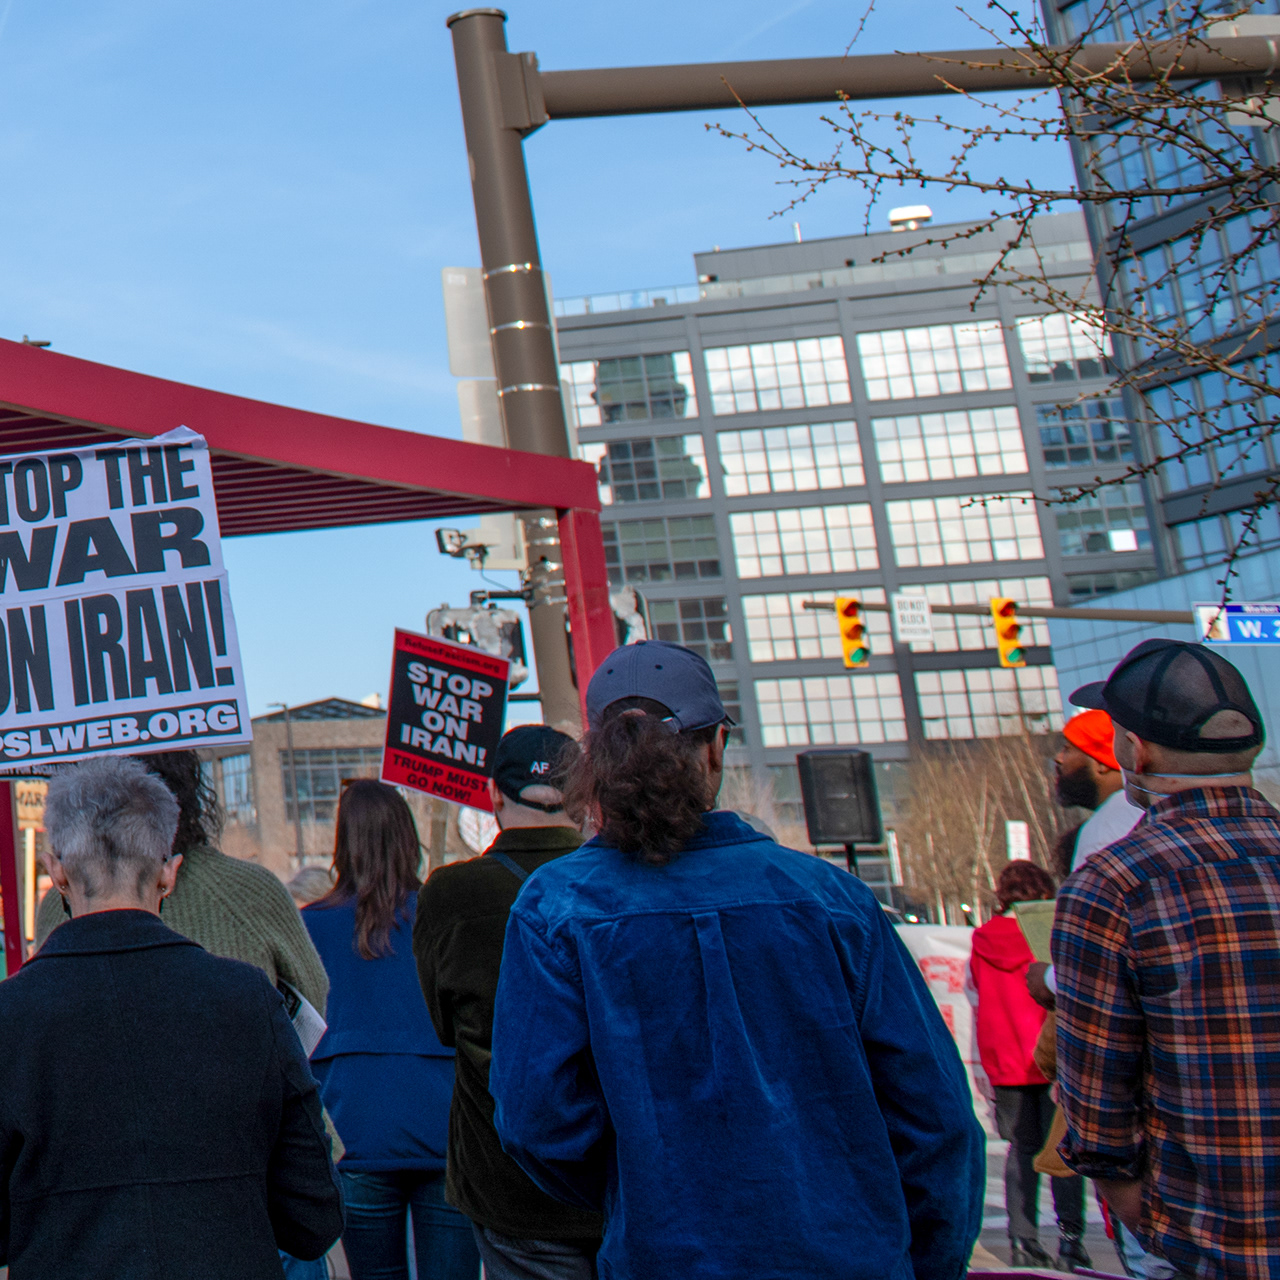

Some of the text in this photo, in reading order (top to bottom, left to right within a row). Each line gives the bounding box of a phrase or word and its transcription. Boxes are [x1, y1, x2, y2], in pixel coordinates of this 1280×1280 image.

[95, 443, 201, 510] THE
[899, 613, 927, 625] BLOCK
[909, 600, 925, 611] NOT
[64, 579, 235, 707] IRAN!
[1235, 619, 1269, 639] W.
[407, 661, 494, 701] STOP
[411, 683, 483, 723] WAR
[421, 709, 469, 741] ON
[400, 723, 487, 768] IRAN!
[392, 754, 488, 793] TRUMP MUST
[530, 761, 550, 775] AF
[406, 773, 473, 802] GO NOW!
